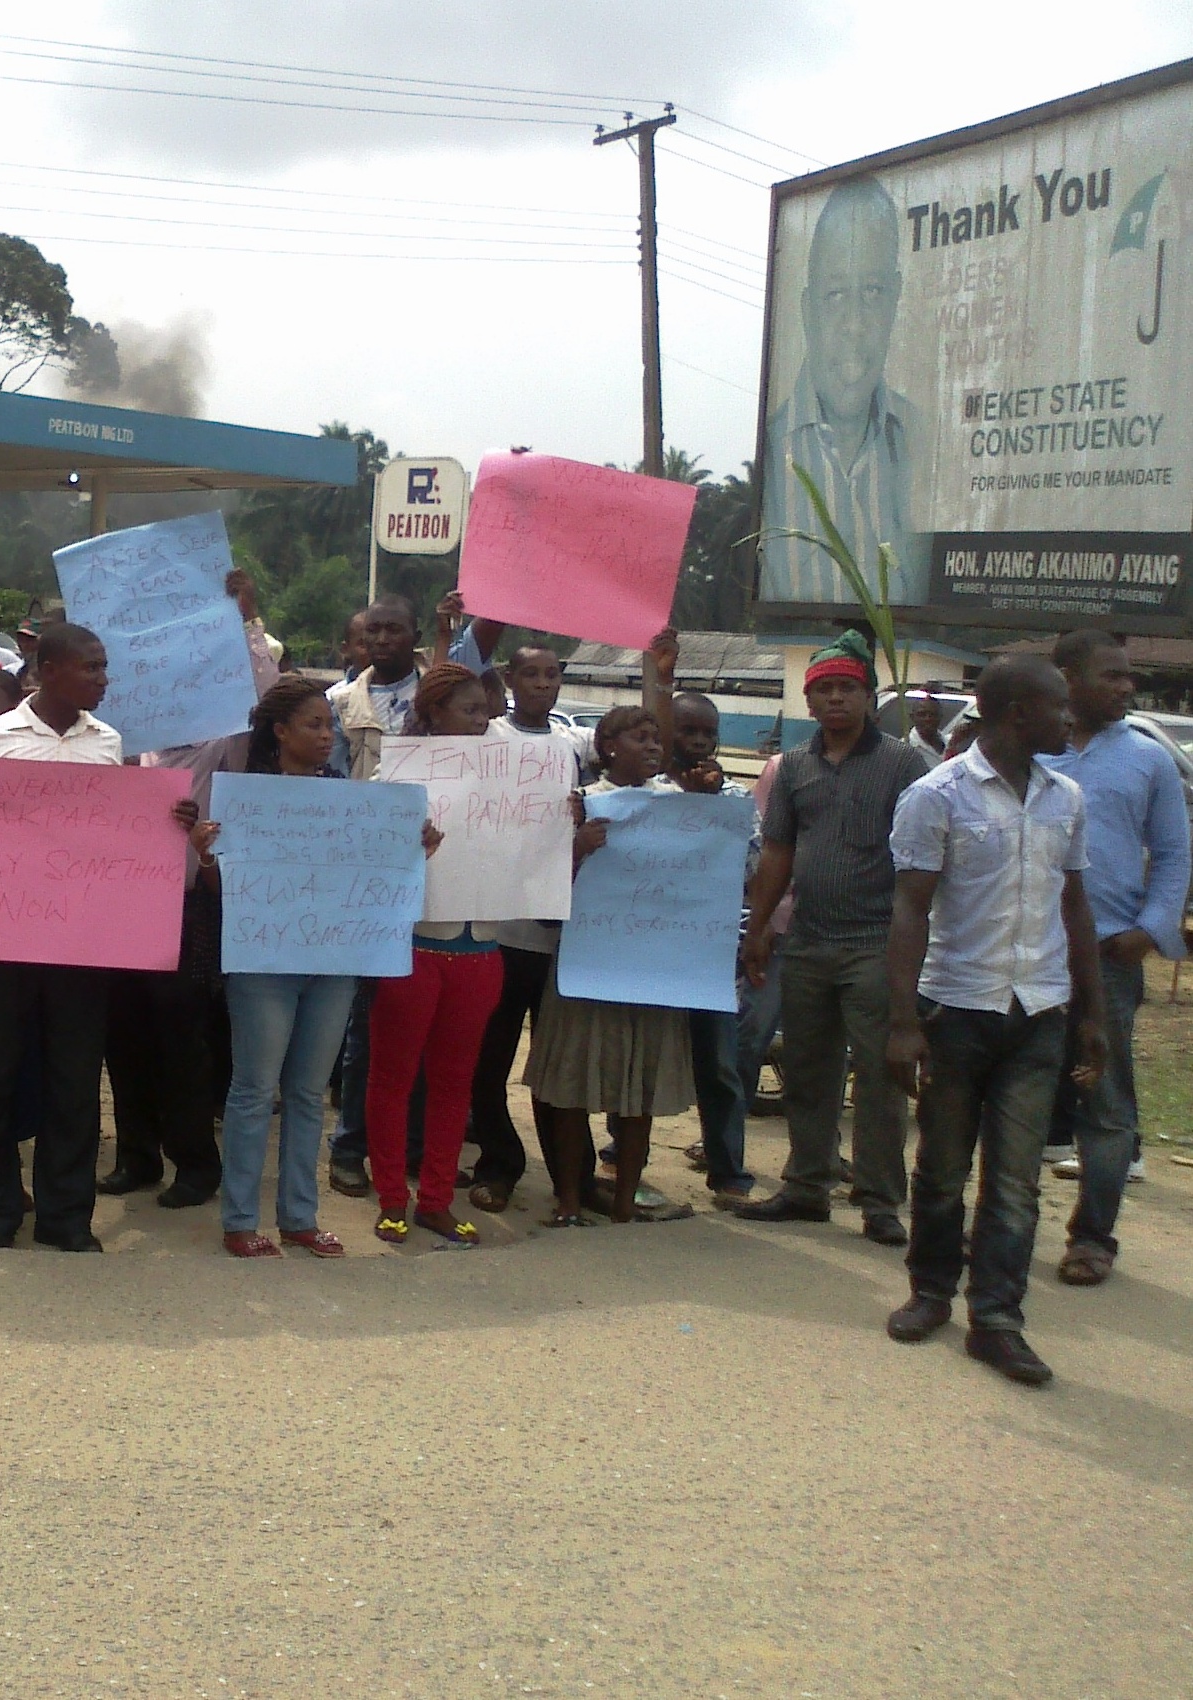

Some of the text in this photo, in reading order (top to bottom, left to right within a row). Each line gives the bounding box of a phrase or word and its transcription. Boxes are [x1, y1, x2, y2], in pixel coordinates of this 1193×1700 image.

[907, 168, 1111, 252] Thank You
[984, 387, 1044, 421] EKET
[1050, 377, 1127, 415] STATE
[49, 418, 99, 438] PEATBON
[970, 413, 1164, 458] CONSTITUENCY
[971, 467, 1173, 491] FOR GIVING ME YOUR MANDATE
[387, 513, 451, 539] PEATBON
[944, 551, 1180, 585] HON. AYANG AKANIMO AYANG
[383, 740, 510, 783] ZENITH
[232, 916, 290, 953] SAY
